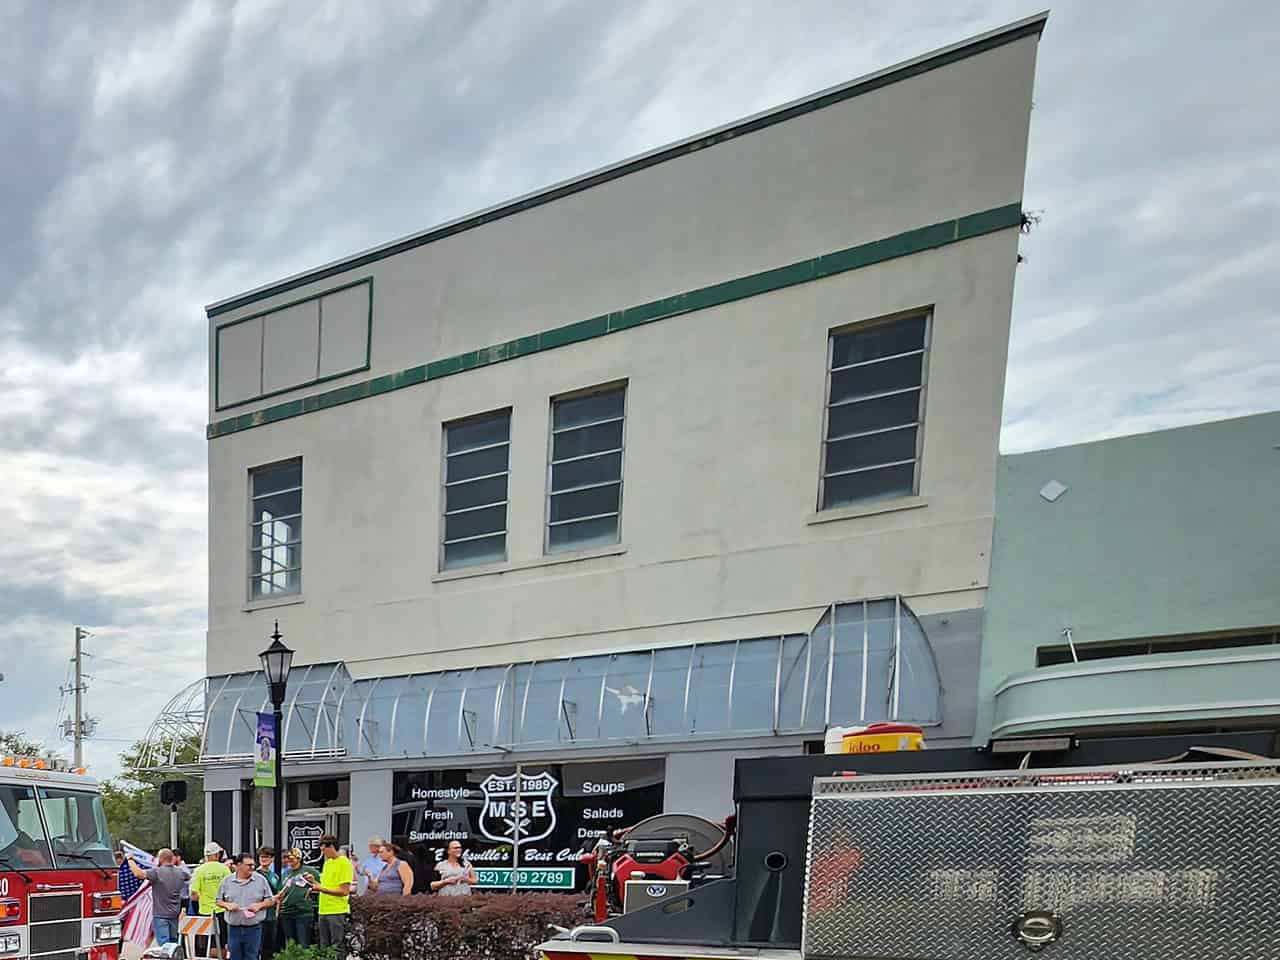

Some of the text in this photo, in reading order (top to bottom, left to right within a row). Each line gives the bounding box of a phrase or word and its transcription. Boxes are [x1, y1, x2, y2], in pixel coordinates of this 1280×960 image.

[487, 780, 551, 791] EST. 1989
[582, 782, 625, 796] Soups
[411, 787, 470, 800] Homestyle
[424, 810, 454, 820] Fresh
[583, 808, 624, 819] Salads
[410, 830, 468, 840] Sandwiches
[524, 849, 554, 861] Best
[531, 872, 564, 883] 2789
